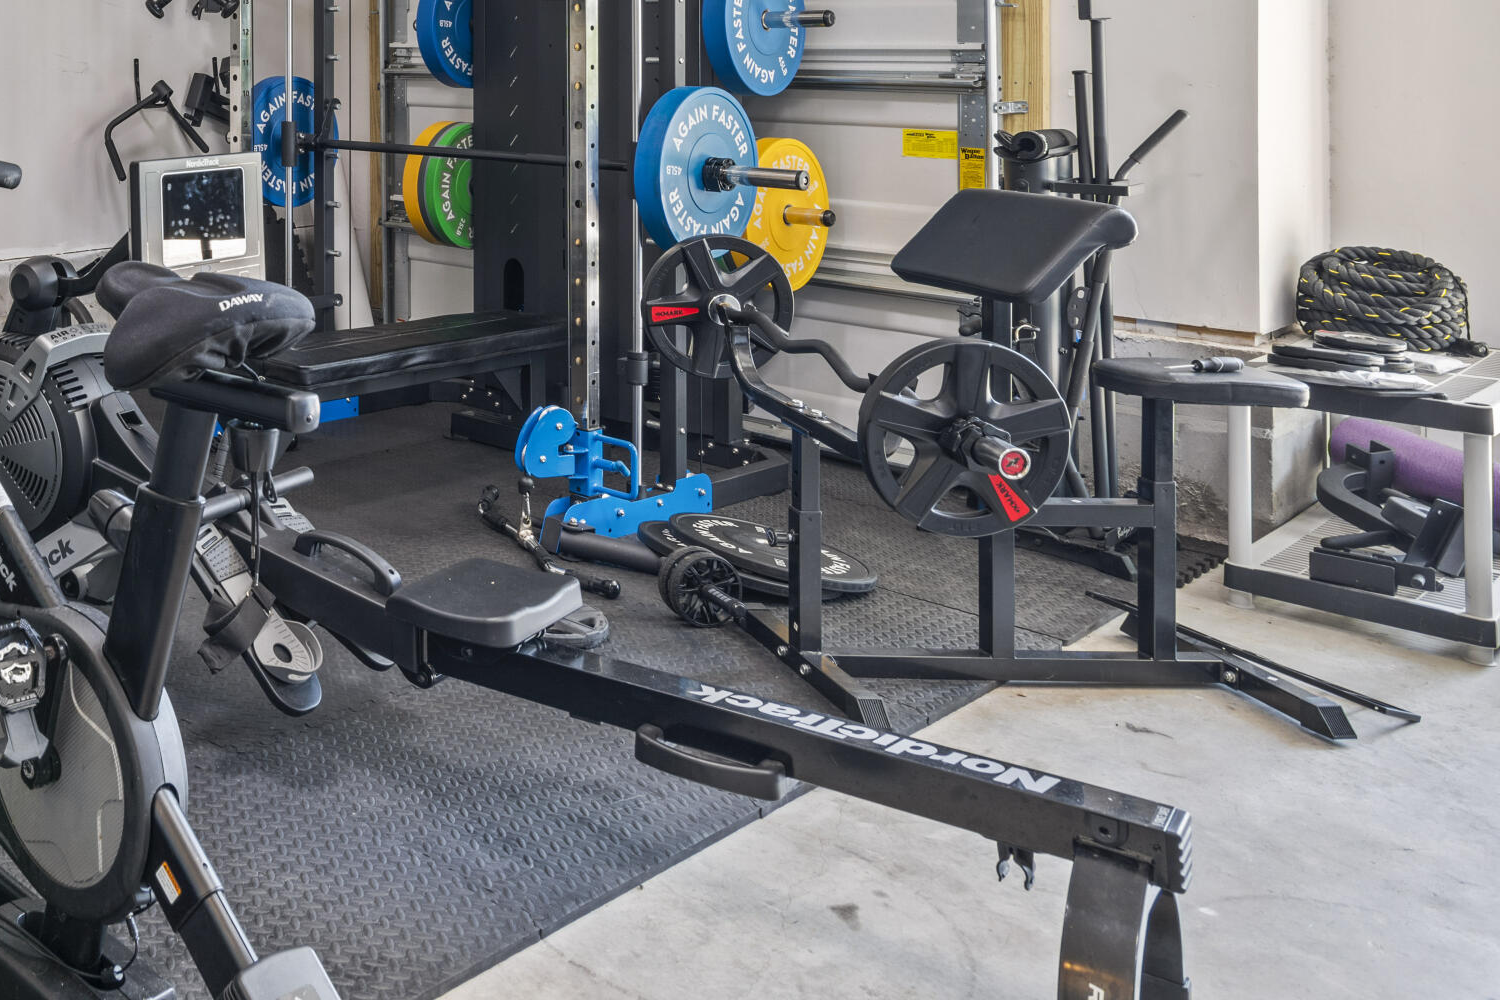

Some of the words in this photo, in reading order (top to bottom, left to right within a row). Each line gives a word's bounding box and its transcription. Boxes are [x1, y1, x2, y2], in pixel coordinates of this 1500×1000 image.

[743, 52, 775, 83] AGAIN
[673, 104, 708, 153] AGAIN
[711, 105, 748, 158] FASTER
[441, 172, 455, 221] AGAIN
[219, 293, 263, 311] DAWAY
[50, 330, 70, 340] AIR
[689, 683, 1061, 794] NordicTrack
